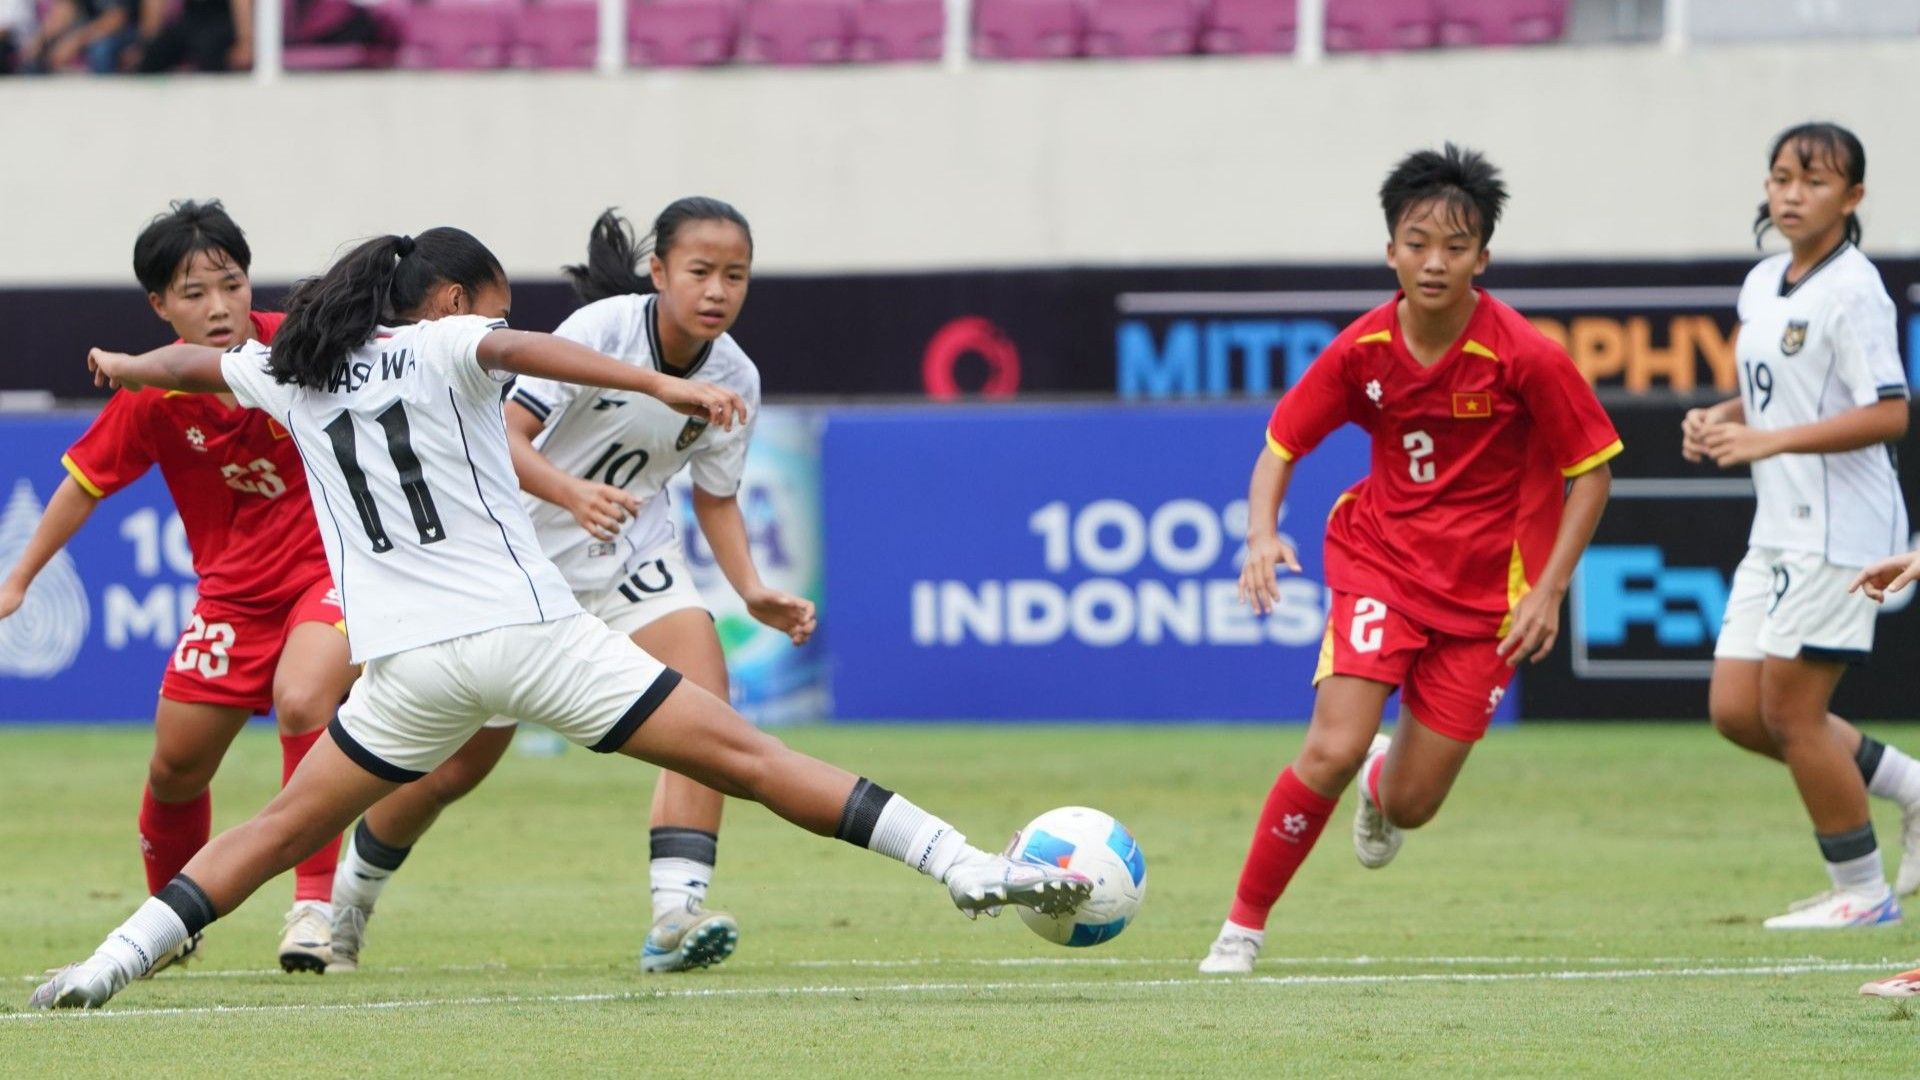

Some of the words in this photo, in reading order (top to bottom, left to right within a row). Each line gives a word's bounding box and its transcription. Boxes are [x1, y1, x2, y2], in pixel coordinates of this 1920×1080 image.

[1530, 315, 1739, 395] PHY
[1745, 361, 1773, 413] 19
[221, 458, 286, 499] 23
[322, 396, 446, 554] 11
[584, 442, 649, 489] 10
[1403, 430, 1435, 483] 2
[618, 559, 673, 603] 10
[911, 577, 1331, 647] INDONES
[1350, 597, 1387, 653] 2
[174, 614, 236, 679] 23
